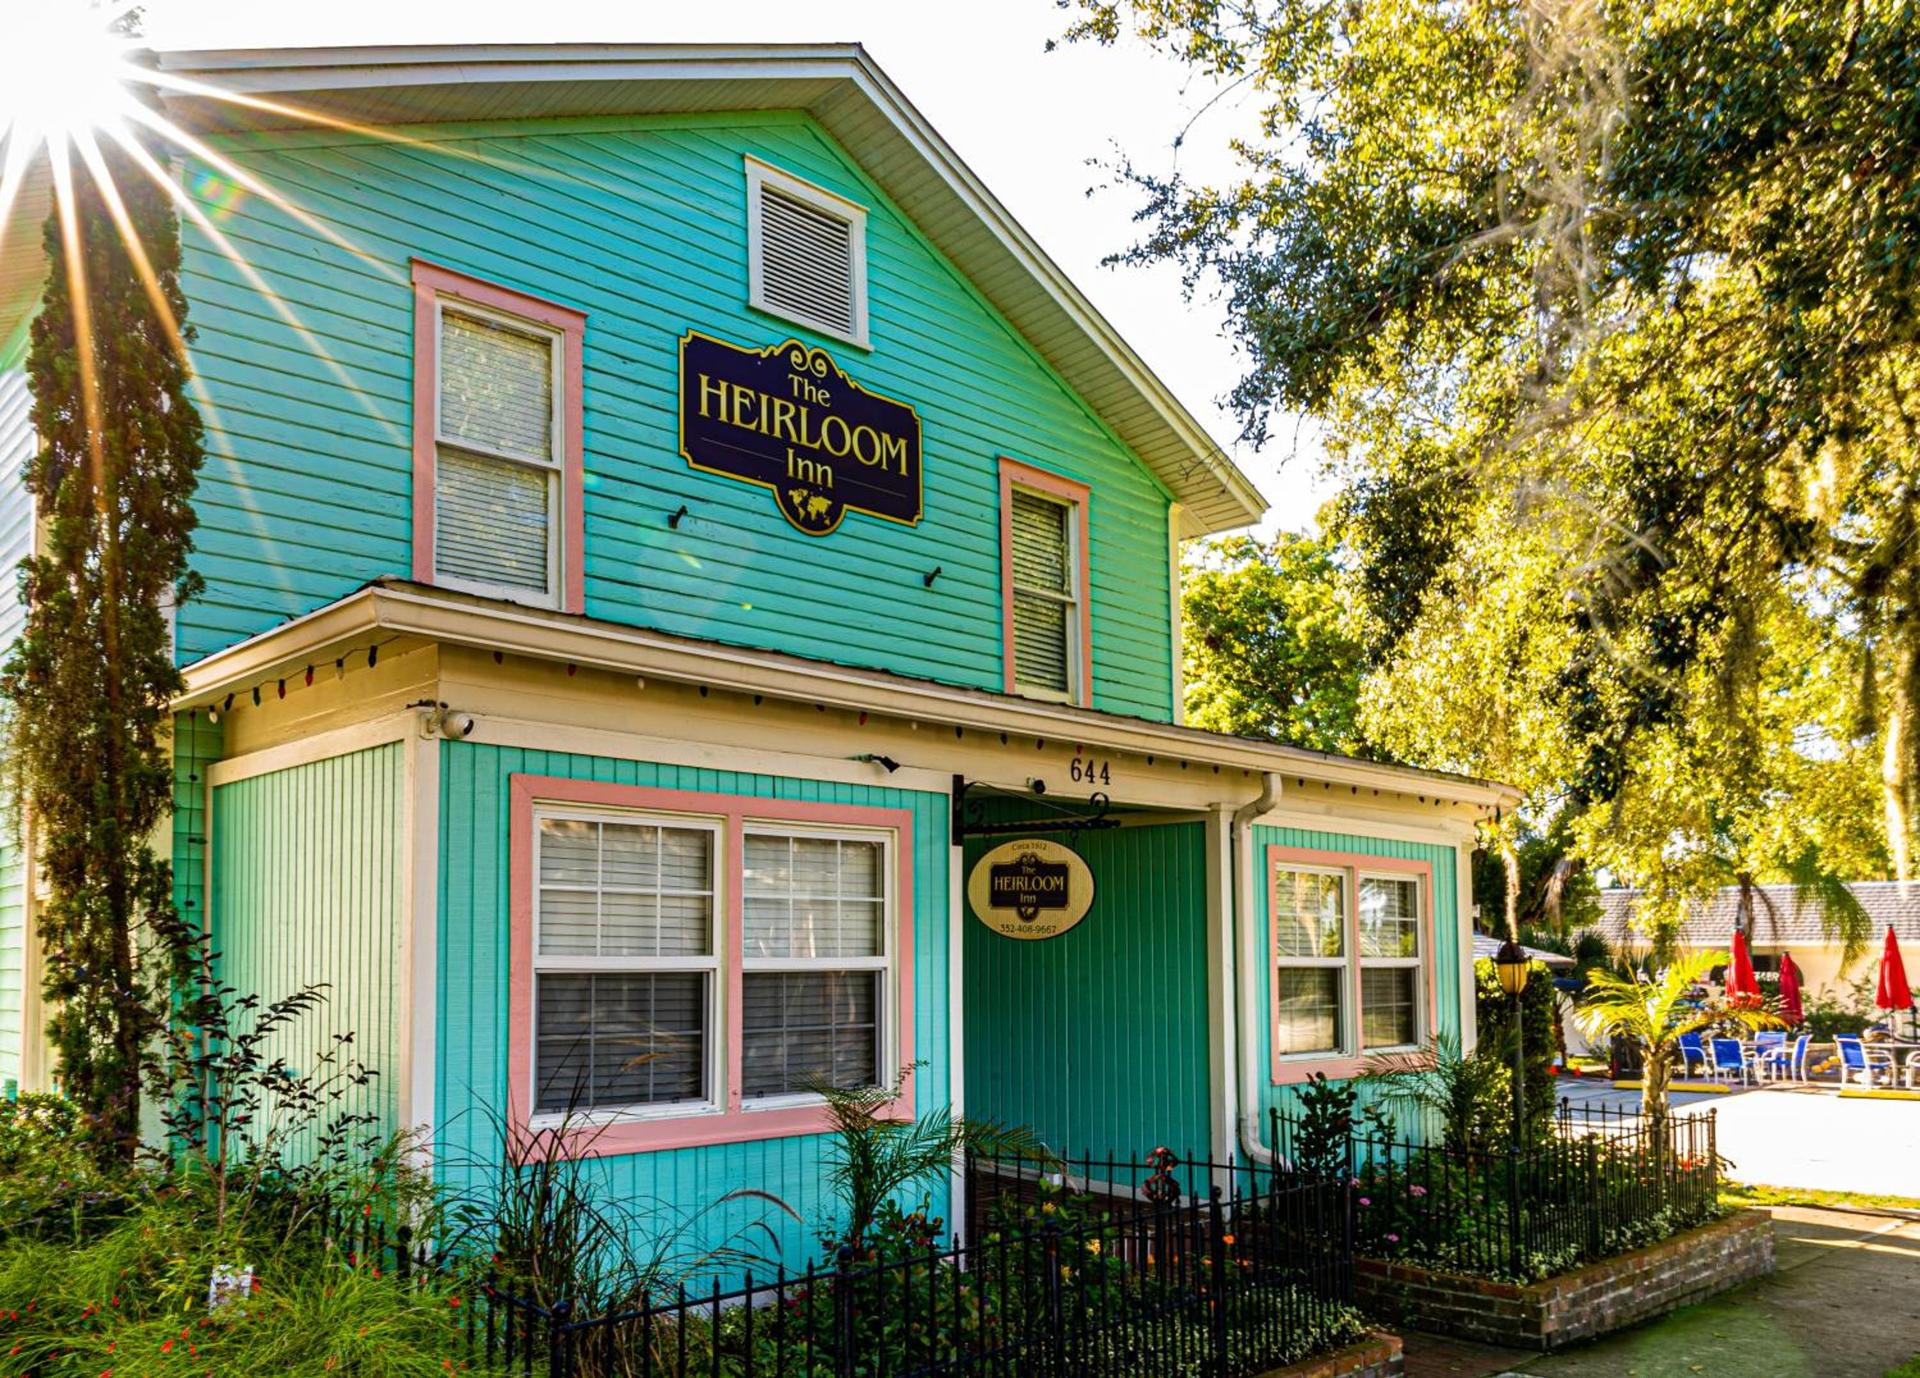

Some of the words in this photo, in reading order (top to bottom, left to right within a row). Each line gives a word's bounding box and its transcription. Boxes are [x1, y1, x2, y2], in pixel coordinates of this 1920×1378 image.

[788, 374, 831, 407] The
[698, 373, 908, 476] HEIRLOOM
[786, 448, 833, 488] Inn
[1071, 758, 1111, 785] 644
[994, 876, 1064, 891] HEIRLOOM
[1022, 866, 1036, 875] The
[1020, 893, 1036, 904] Inn
